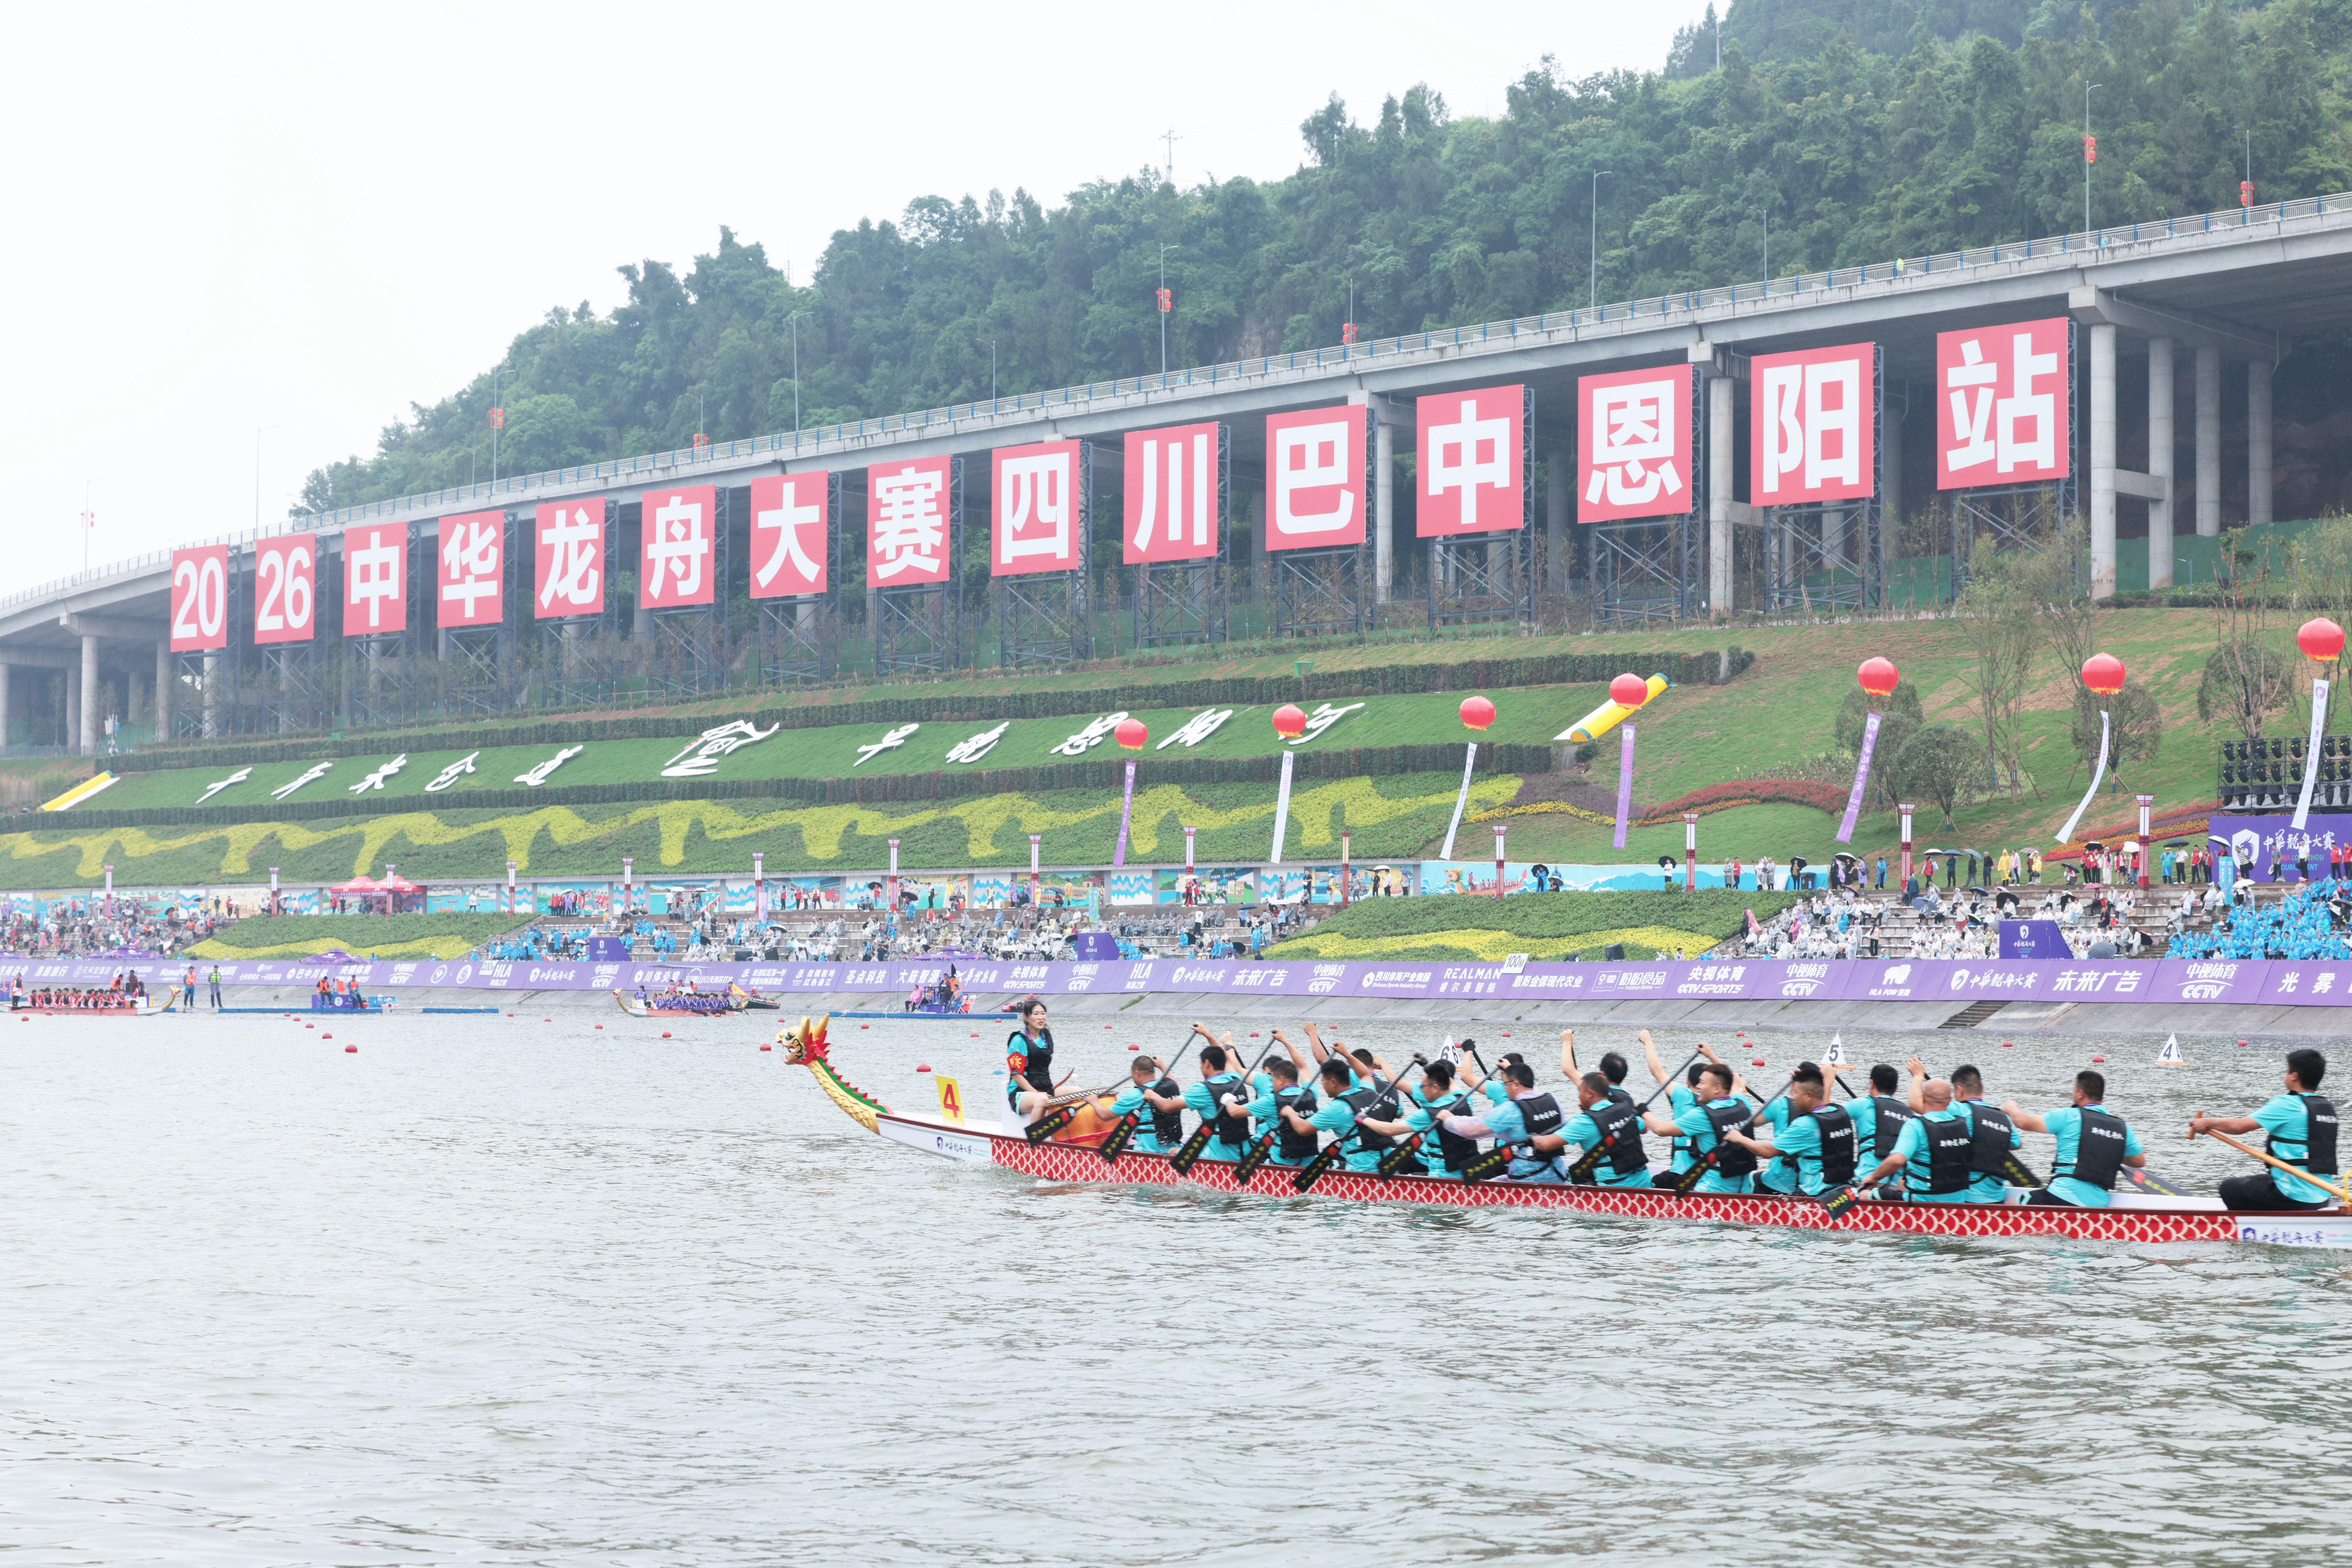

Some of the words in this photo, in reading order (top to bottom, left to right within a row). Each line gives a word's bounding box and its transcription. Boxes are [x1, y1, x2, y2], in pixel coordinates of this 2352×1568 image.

[341, 965, 373, 975] 央视体育
[394, 963, 418, 973] 中视体育
[493, 964, 512, 978] HLA
[594, 965, 620, 975] 中视体育
[807, 969, 835, 977] 度假胜地
[1010, 965, 1048, 978] 央视体育
[1072, 964, 1099, 976] 中视体育
[1130, 963, 1153, 979] HLA
[1313, 964, 1346, 977] 中视体育
[1444, 968, 1503, 979] REALMAN
[1687, 965, 1746, 981] 央视体育
[1786, 963, 1829, 978] 中视体育
[2186, 963, 2239, 979] 中视体育
[389, 976, 409, 984] CCTV
[592, 978, 613, 988] CCTV
[803, 978, 832, 986] 红色通江
[845, 970, 886, 984] 圣点科技
[896, 969, 941, 984] 大陆智源
[1231, 969, 1288, 986] 未来广告
[1374, 971, 1432, 982] 四川体育产业集团
[1512, 975, 1583, 987] 恩阳金儒现代农业
[1619, 972, 1666, 986] 盼盼食品
[2052, 969, 2143, 992] 未来广告
[2277, 972, 2352, 993] 光雾
[1017, 981, 1046, 989] SPORTS
[1068, 980, 1091, 991] CCTV
[1125, 981, 1146, 989] 海澜之家
[1308, 981, 1336, 993] CCTV
[1439, 982, 1497, 993] 睿尔曼智能
[1677, 984, 1702, 993] CCTV
[1698, 984, 1744, 993] SPORTS
[1782, 983, 1818, 996] CCTV
[2182, 984, 2226, 999] CCTV
[1441, 1046, 1450, 1060] 6
[1452, 1045, 1459, 1064] 6
[1829, 1044, 1839, 1062] 5
[2163, 1044, 2173, 1060] 4
[944, 1084, 960, 1118] 4
